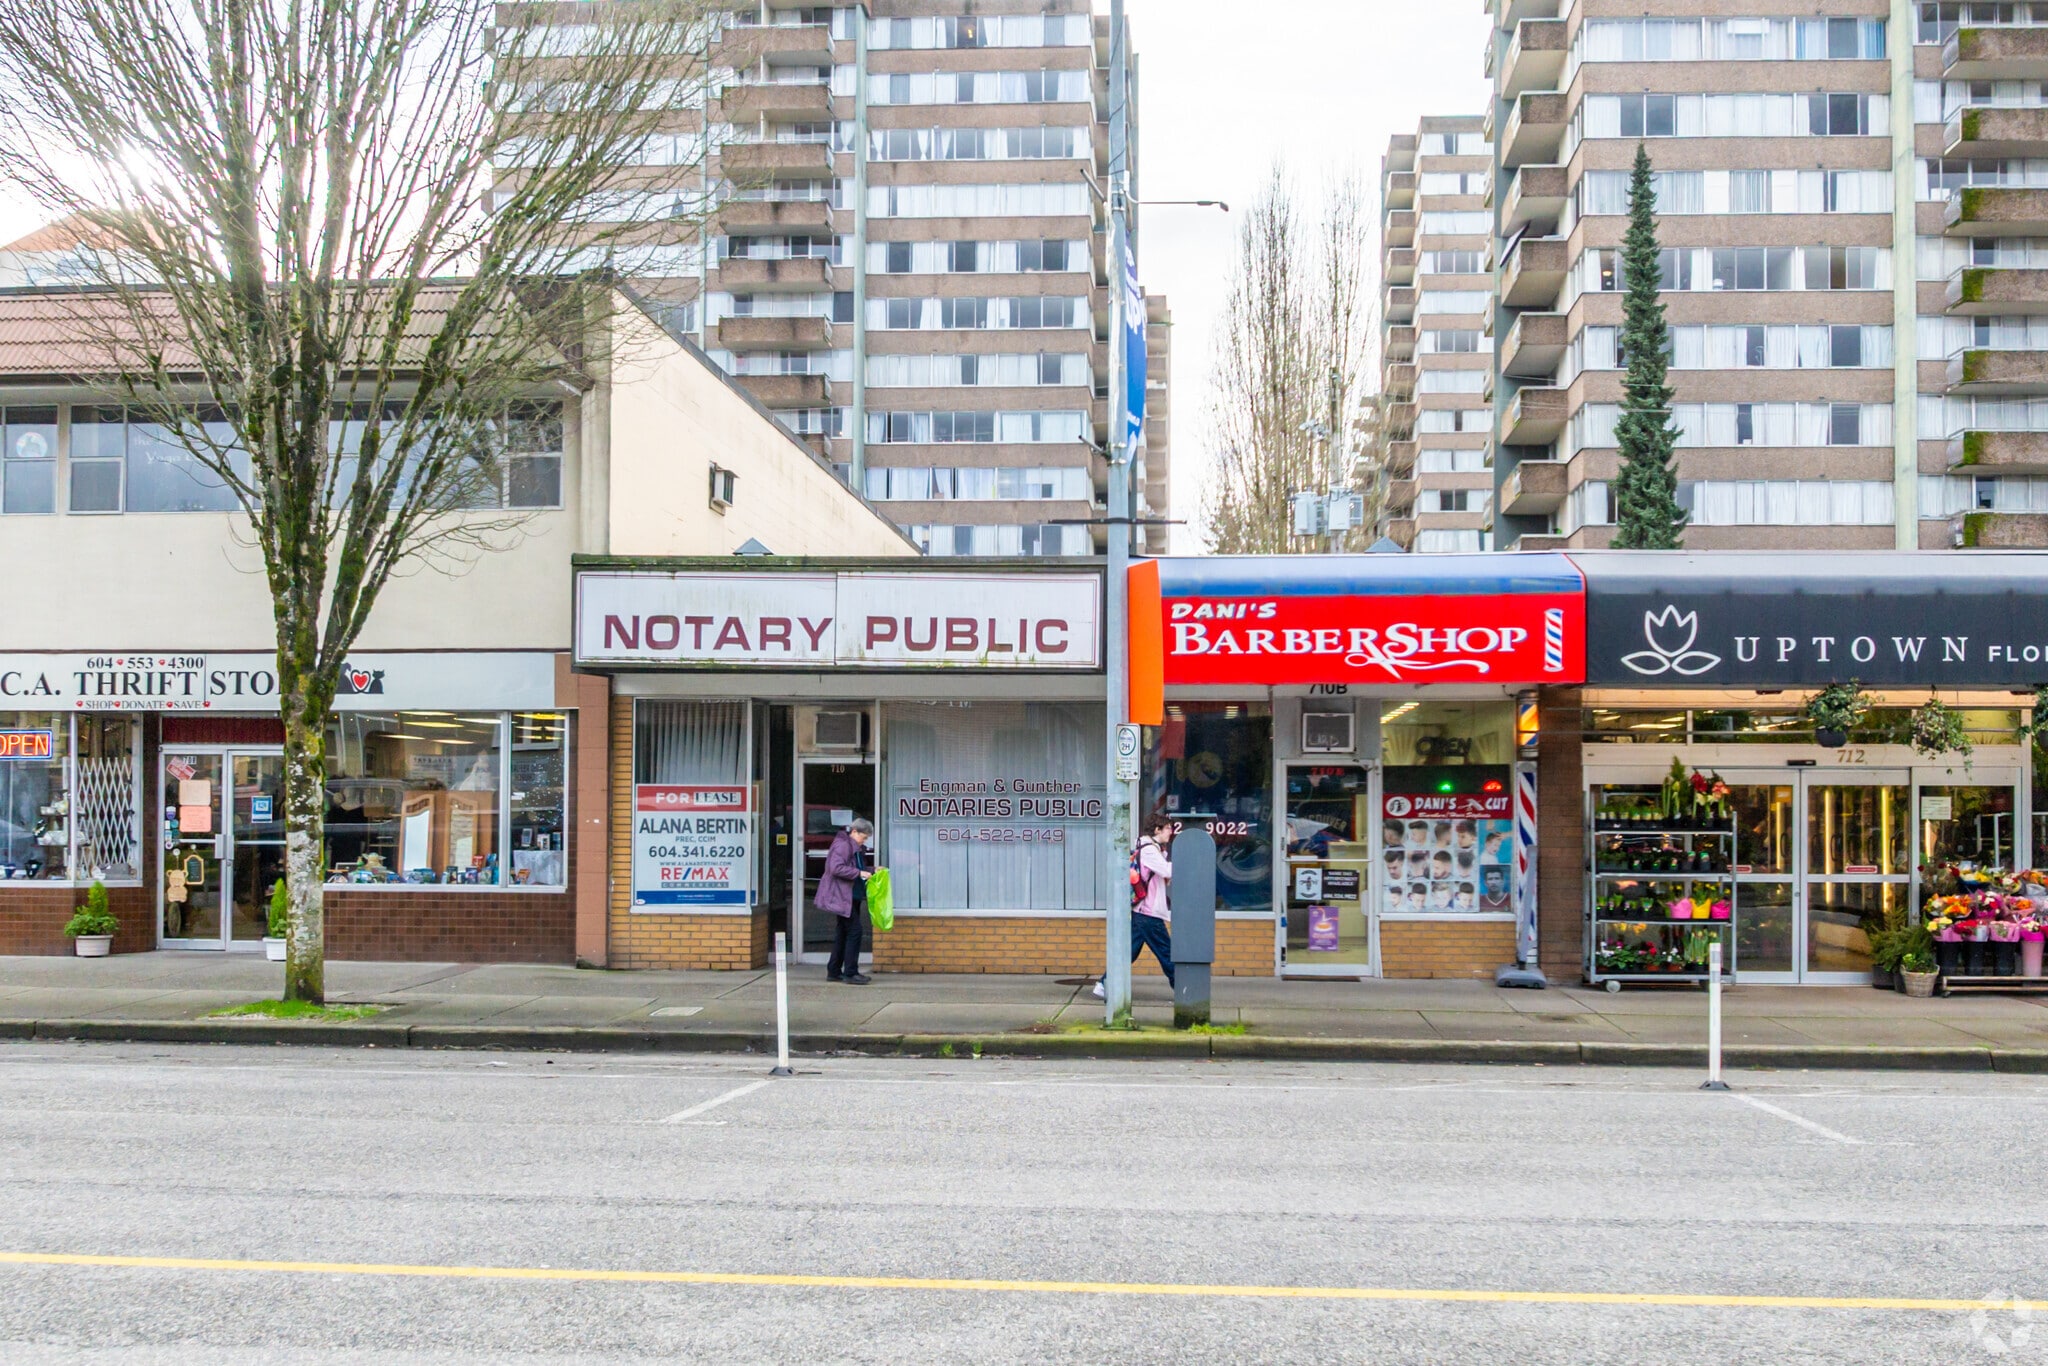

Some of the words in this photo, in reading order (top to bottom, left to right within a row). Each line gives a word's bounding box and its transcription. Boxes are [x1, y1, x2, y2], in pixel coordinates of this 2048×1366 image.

[1171, 602, 1277, 620] DANI'S
[604, 614, 834, 651] NOTARY
[866, 616, 1069, 653] PUBLIC
[1734, 636, 1969, 663] UPTOWN
[87, 657, 113, 669] 604
[127, 657, 154, 669] 553
[168, 656, 204, 669] 4300
[74, 671, 198, 696] THRIFT
[210, 670, 281, 696] STO
[86, 700, 114, 709] SHOP
[121, 700, 166, 709] DONATE
[174, 700, 201, 709] SAVE
[1836, 749, 1866, 763] 712
[831, 764, 845, 773] 710
[920, 779, 986, 796] Engman
[993, 779, 1006, 792] &
[1012, 778, 1081, 793] Gunther
[656, 792, 690, 804] FOR
[695, 792, 738, 804] LEASE
[1415, 797, 1457, 810] DANI'S
[1485, 797, 1509, 810] CUT
[899, 799, 1011, 817] NOTARIES
[1019, 799, 1101, 818] PUBLIC
[639, 818, 693, 834] ALANA
[1205, 821, 1248, 835] 9022
[937, 829, 1064, 842] 604-522-8149
[649, 846, 745, 858] 604.341.6220
[661, 867, 729, 880] RE/MAX
